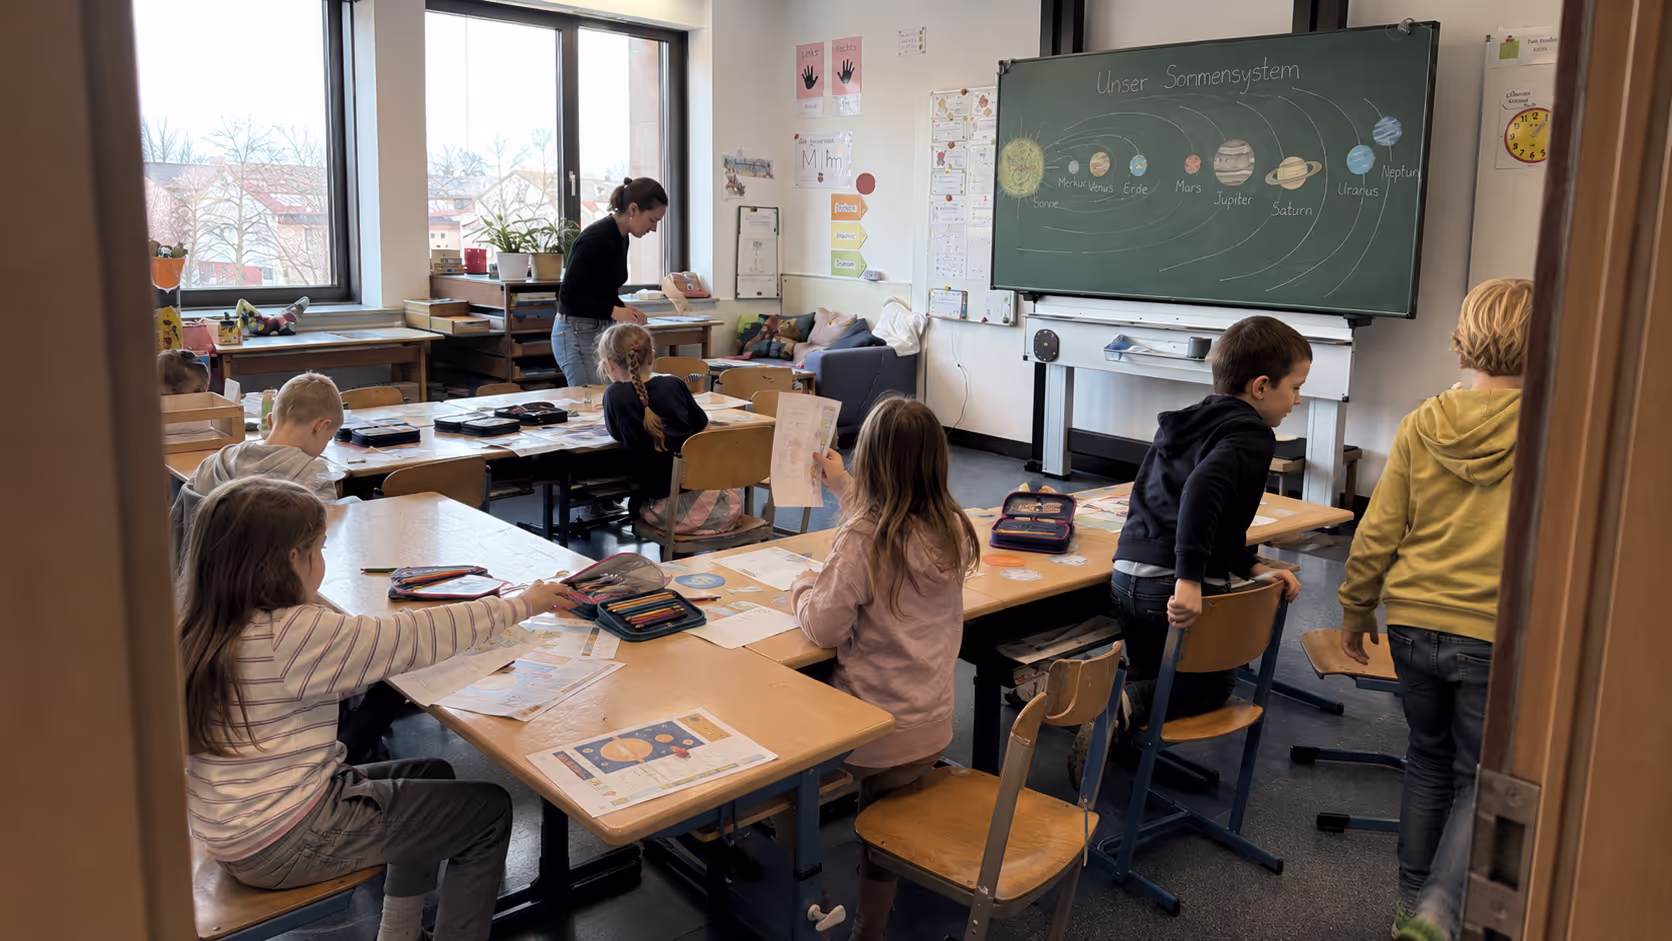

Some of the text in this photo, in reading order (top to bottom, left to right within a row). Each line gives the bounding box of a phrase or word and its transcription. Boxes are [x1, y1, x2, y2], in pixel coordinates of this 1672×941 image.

[1097, 70, 1148, 94] Unser
[1058, 176, 1087, 188] Merkur
[1088, 181, 1114, 193] Venus
[1123, 182, 1148, 194] Erde
[1175, 180, 1202, 193] Mars
[1337, 182, 1380, 197] Uranus
[1214, 191, 1255, 211] Jupiter
[1270, 201, 1313, 216] Saturn
